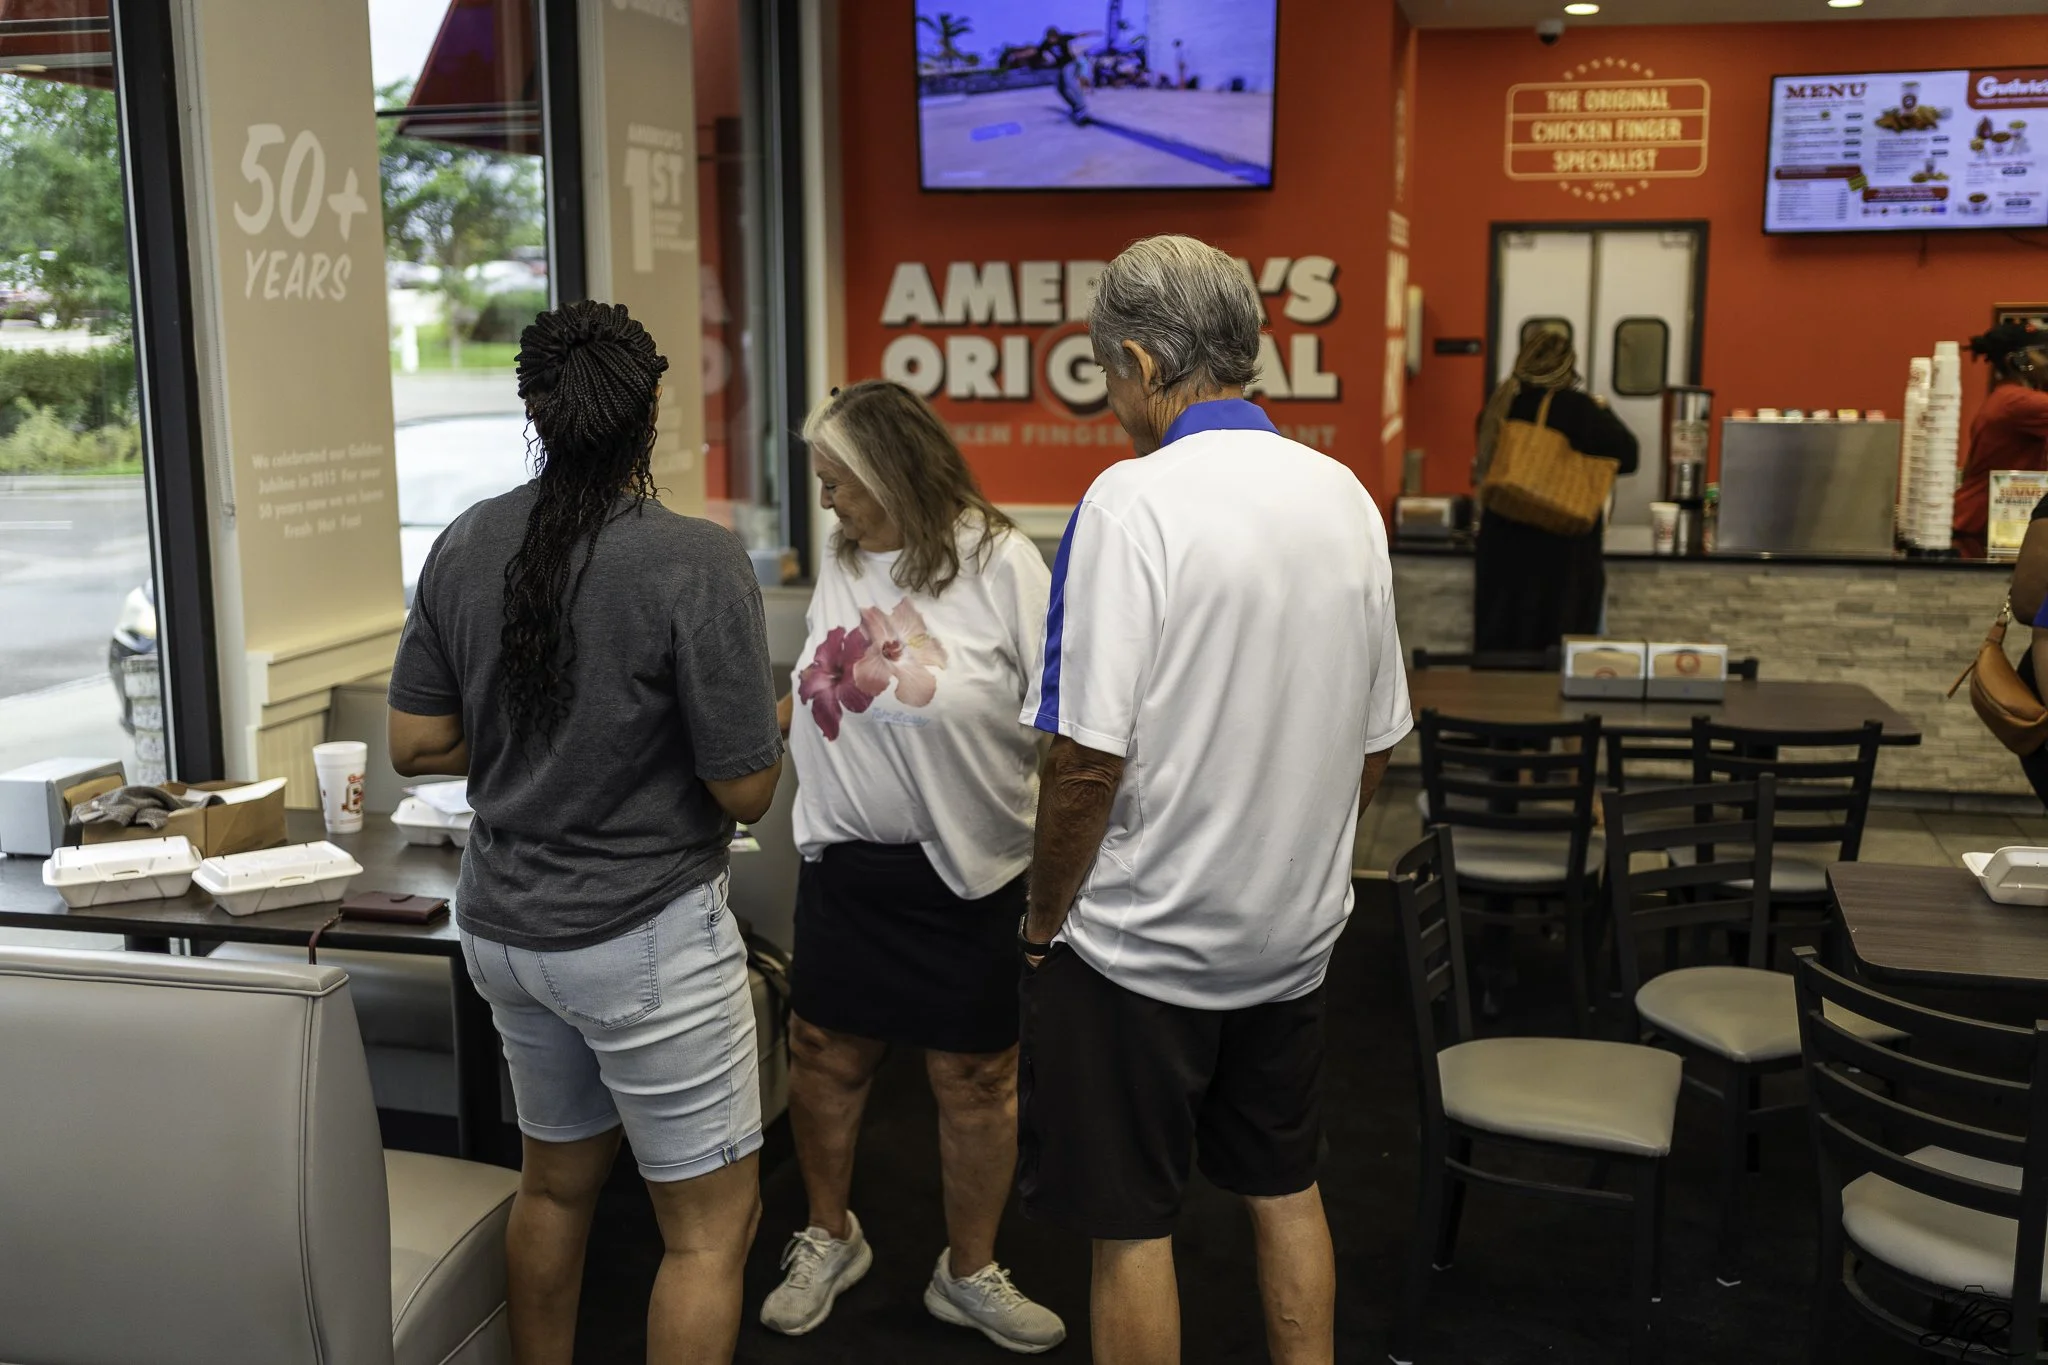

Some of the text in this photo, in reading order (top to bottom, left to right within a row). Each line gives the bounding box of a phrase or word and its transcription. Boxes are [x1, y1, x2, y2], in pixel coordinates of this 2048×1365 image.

[1546, 88, 1669, 111] THE ORIGINAL
[1785, 82, 1867, 99] MENU
[1532, 118, 1682, 142] CHICKEN FINGER
[1553, 149, 1658, 172] SPECIALIST
[233, 123, 368, 243] 50+
[245, 248, 352, 301] YEARS
[880, 255, 1338, 325] AMER'S
[881, 333, 1338, 405] ORIGAL
